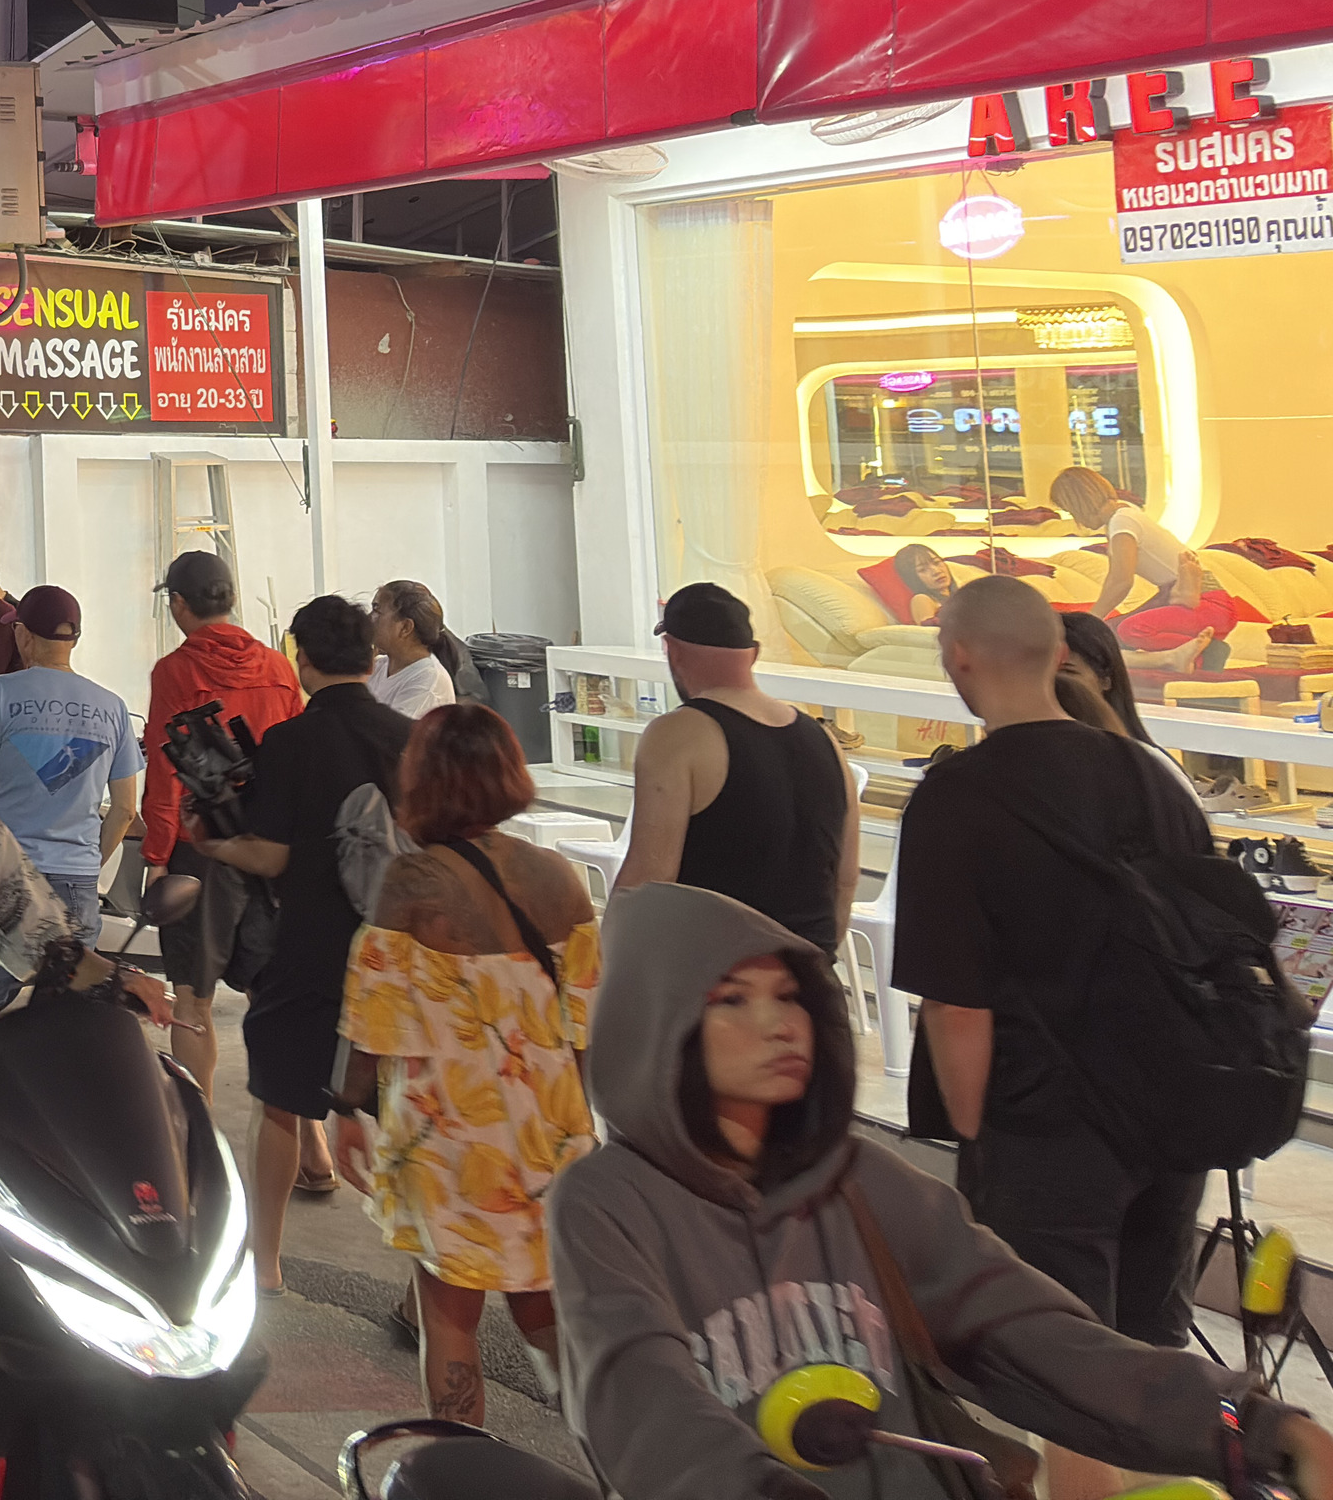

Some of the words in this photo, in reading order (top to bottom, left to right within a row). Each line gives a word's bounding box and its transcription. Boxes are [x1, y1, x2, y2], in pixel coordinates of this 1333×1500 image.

[967, 57, 1268, 158] AREE
[1123, 216, 1261, 253] 0970291190
[166, 298, 252, 332] รับสมัคร
[157, 391, 192, 414] อายุ
[197, 388, 246, 408] 20-33
[247, 388, 264, 409] ปี
[8, 699, 115, 724] DEVOCEAN
